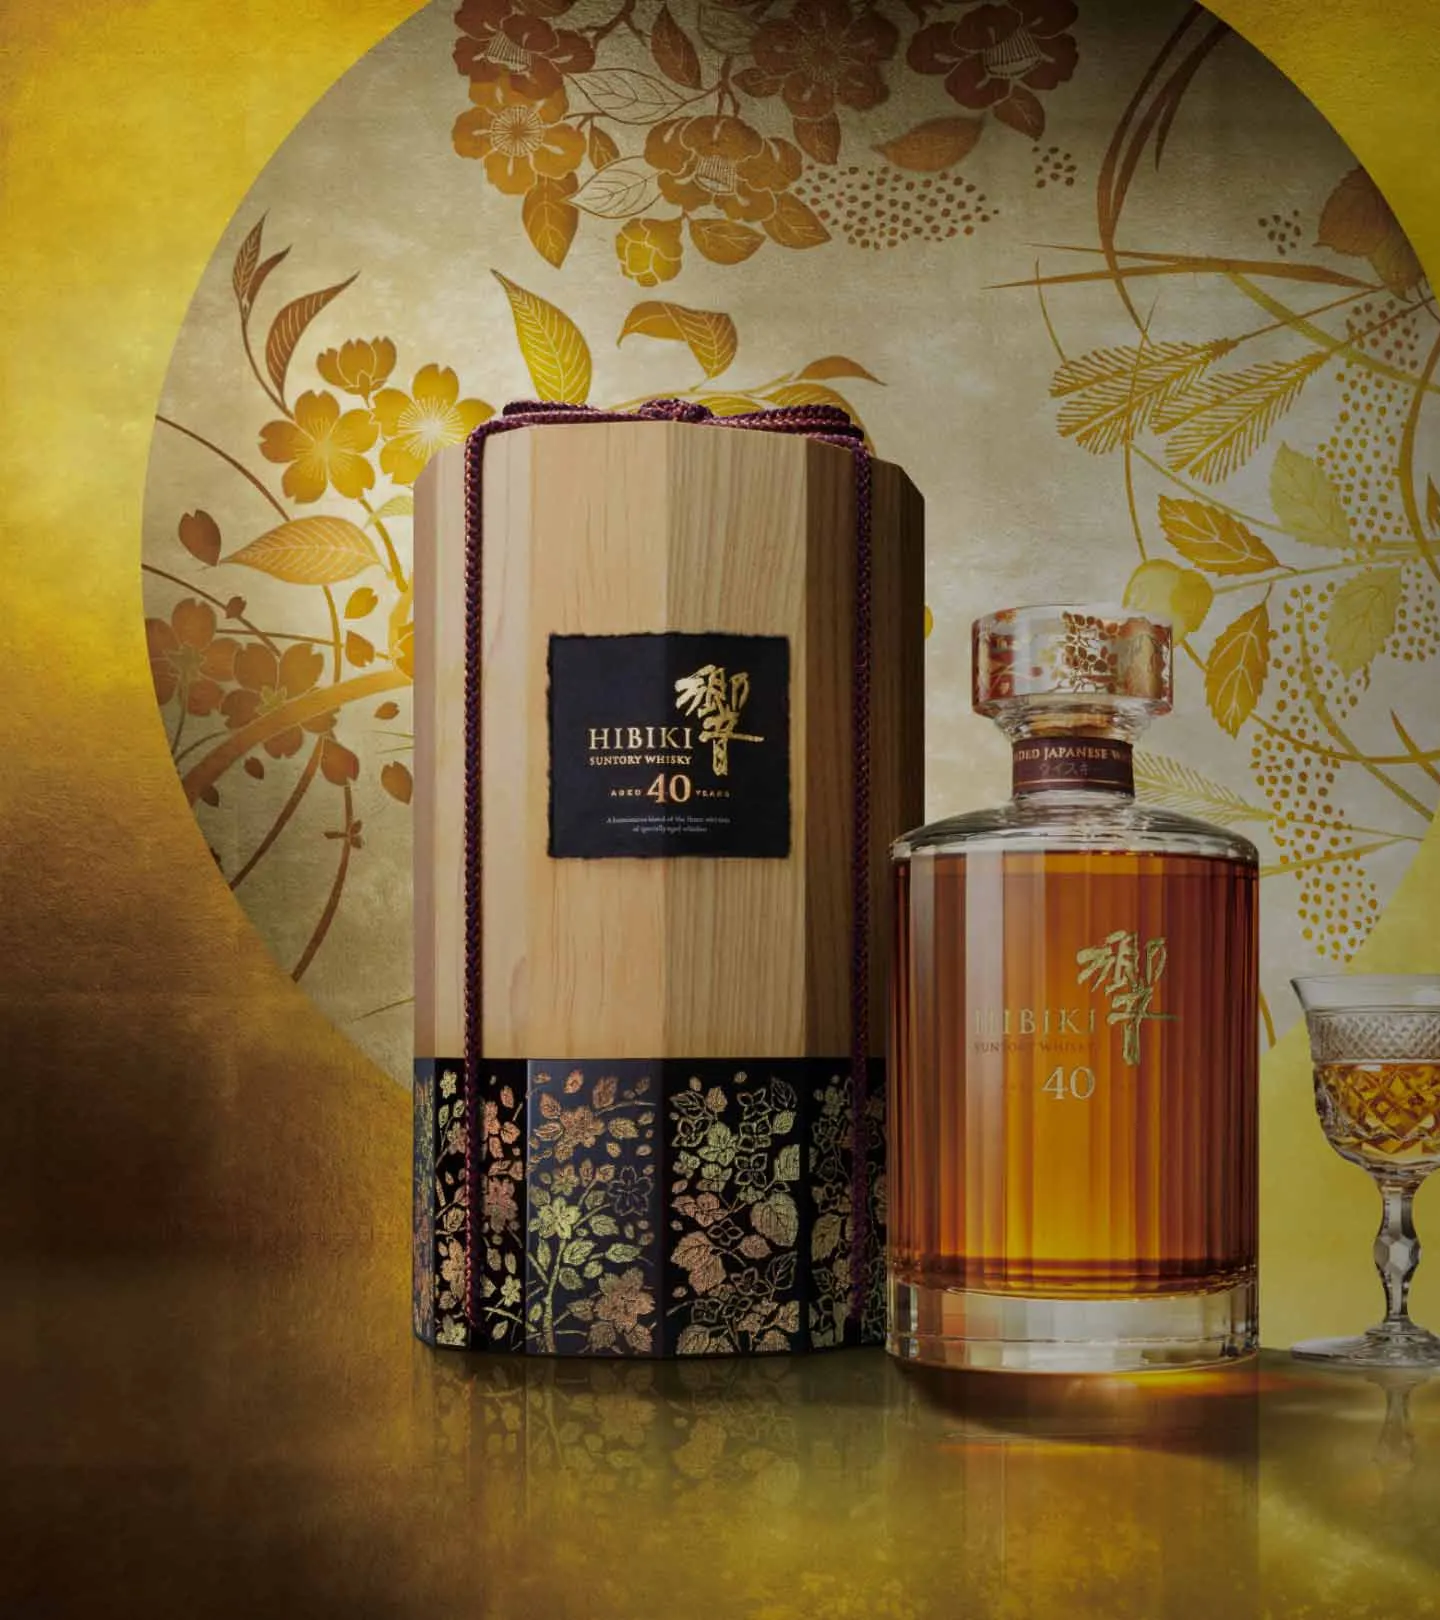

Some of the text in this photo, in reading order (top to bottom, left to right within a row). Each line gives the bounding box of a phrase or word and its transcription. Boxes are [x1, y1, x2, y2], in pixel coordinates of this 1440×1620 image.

[674, 664, 764, 776] 響
[588, 727, 693, 750] HIBIKI
[589, 754, 693, 766] SUNTORY WHISKY
[1043, 746, 1109, 761] JAPANESE
[610, 773, 730, 804] AGED 40 YEARS
[1076, 929, 1181, 1066] 響
[974, 1008, 1096, 1035] HIBIKI
[1042, 1066, 1096, 1100] 40
